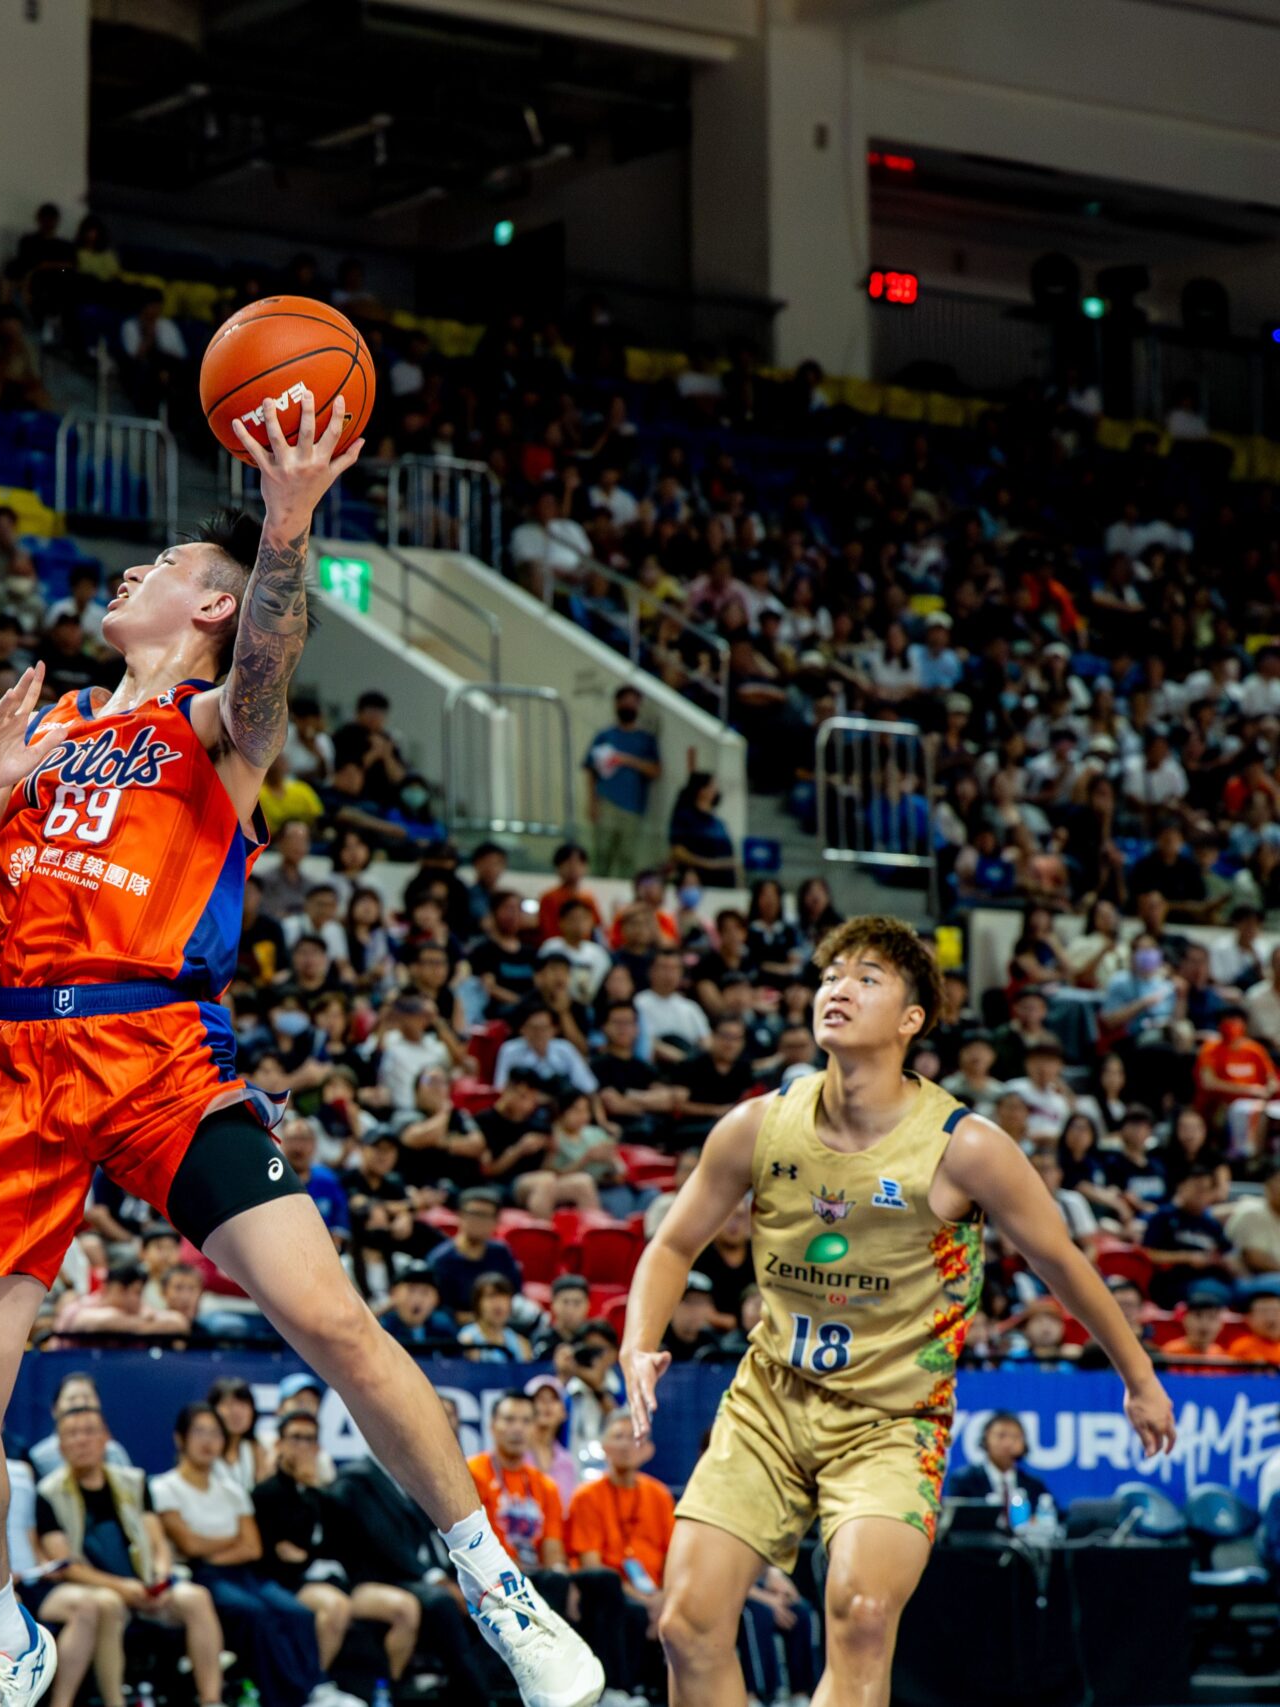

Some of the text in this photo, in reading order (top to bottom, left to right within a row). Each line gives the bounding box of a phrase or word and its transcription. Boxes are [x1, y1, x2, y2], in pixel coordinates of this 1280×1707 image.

[23, 725, 183, 810] Pilots
[42, 784, 122, 845] 69
[50, 868, 100, 891] ARCHILAND
[764, 1251, 891, 1292] Zenhoren
[789, 1312, 853, 1375] 18
